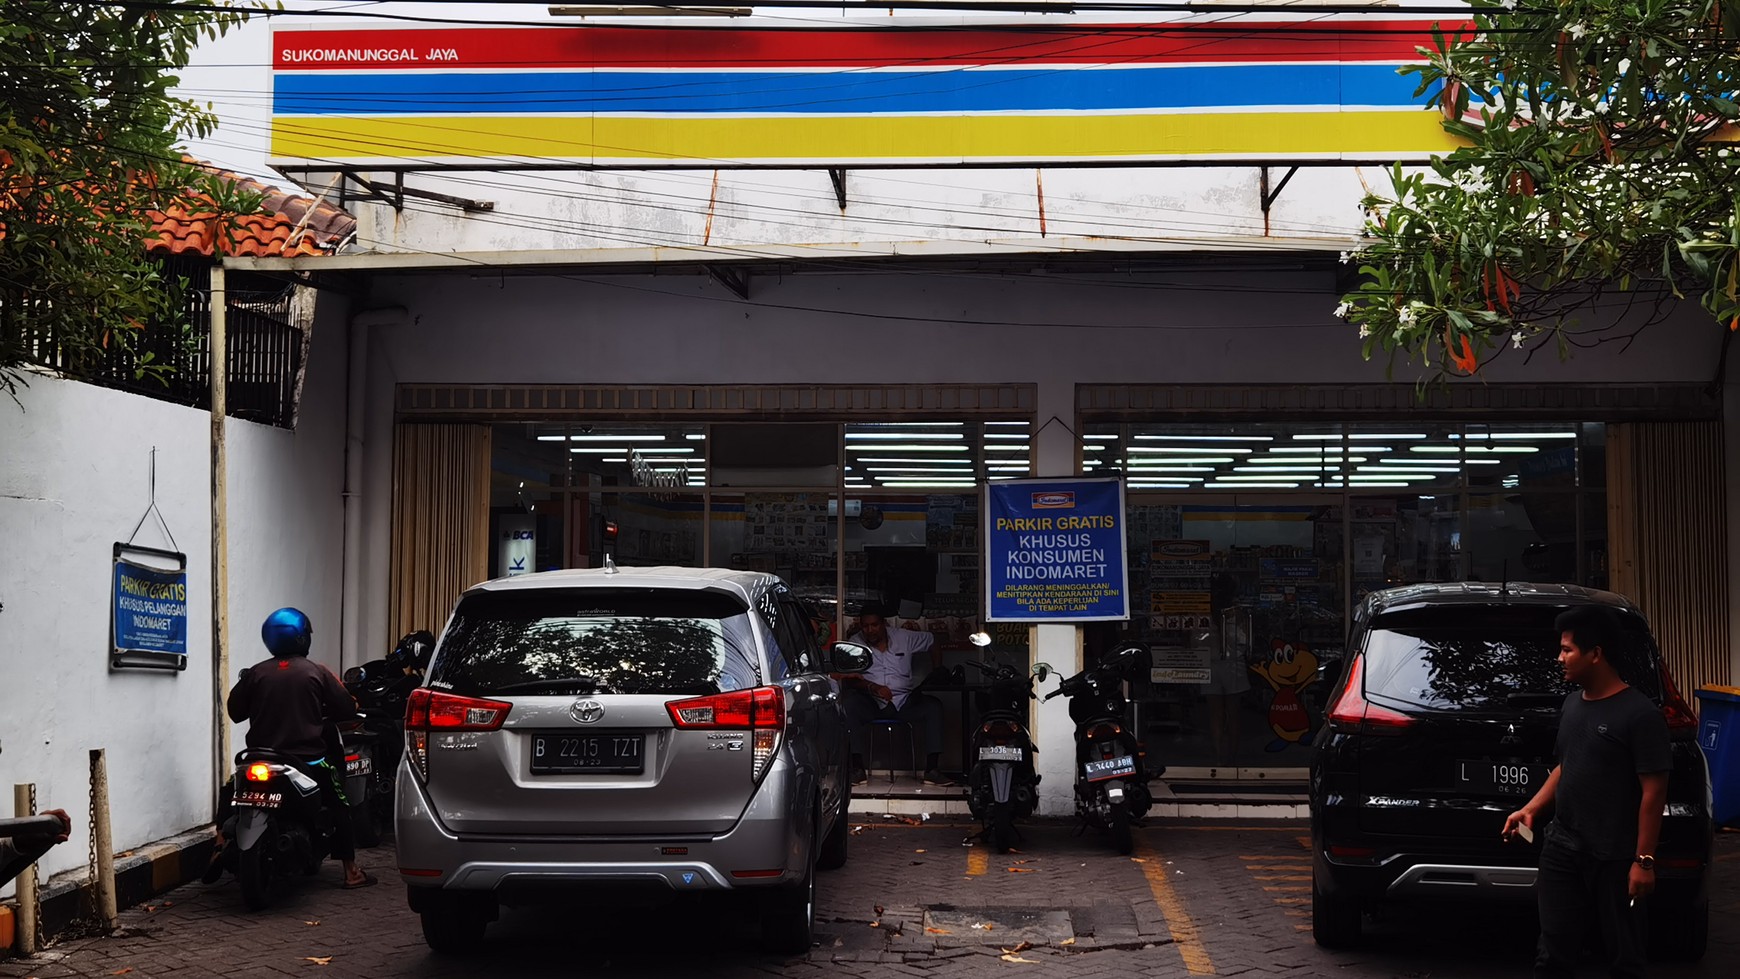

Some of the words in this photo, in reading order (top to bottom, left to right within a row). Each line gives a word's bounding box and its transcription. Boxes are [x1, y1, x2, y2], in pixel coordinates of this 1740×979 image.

[281, 48, 418, 62] SUKOMANUNGGAL
[425, 48, 458, 61] JAYA
[996, 517, 1052, 531] PARKIR
[1056, 515, 1114, 530] GRATIS
[512, 530, 534, 540] BCA
[1019, 533, 1091, 549] KHUSUS
[1008, 549, 1104, 564] KONSUMEN
[1006, 564, 1107, 579] INDOMARET
[120, 574, 151, 597] PARKIR
[149, 583, 186, 601] GRATIS
[1045, 590, 1092, 598] KENDARAAN
[119, 596, 145, 613] KHUSUS
[144, 601, 186, 617] PELANGGAN
[132, 614, 172, 631] INDOMARET
[536, 739, 545, 757] B
[560, 739, 599, 757] 2215
[613, 738, 640, 757] TZT
[1461, 762, 1470, 781] L
[1491, 765, 1529, 785] 1996
[233, 790, 238, 799] L
[242, 791, 266, 800] 5294
[269, 792, 282, 801] MD
[1365, 795, 1421, 807] XPANDER
